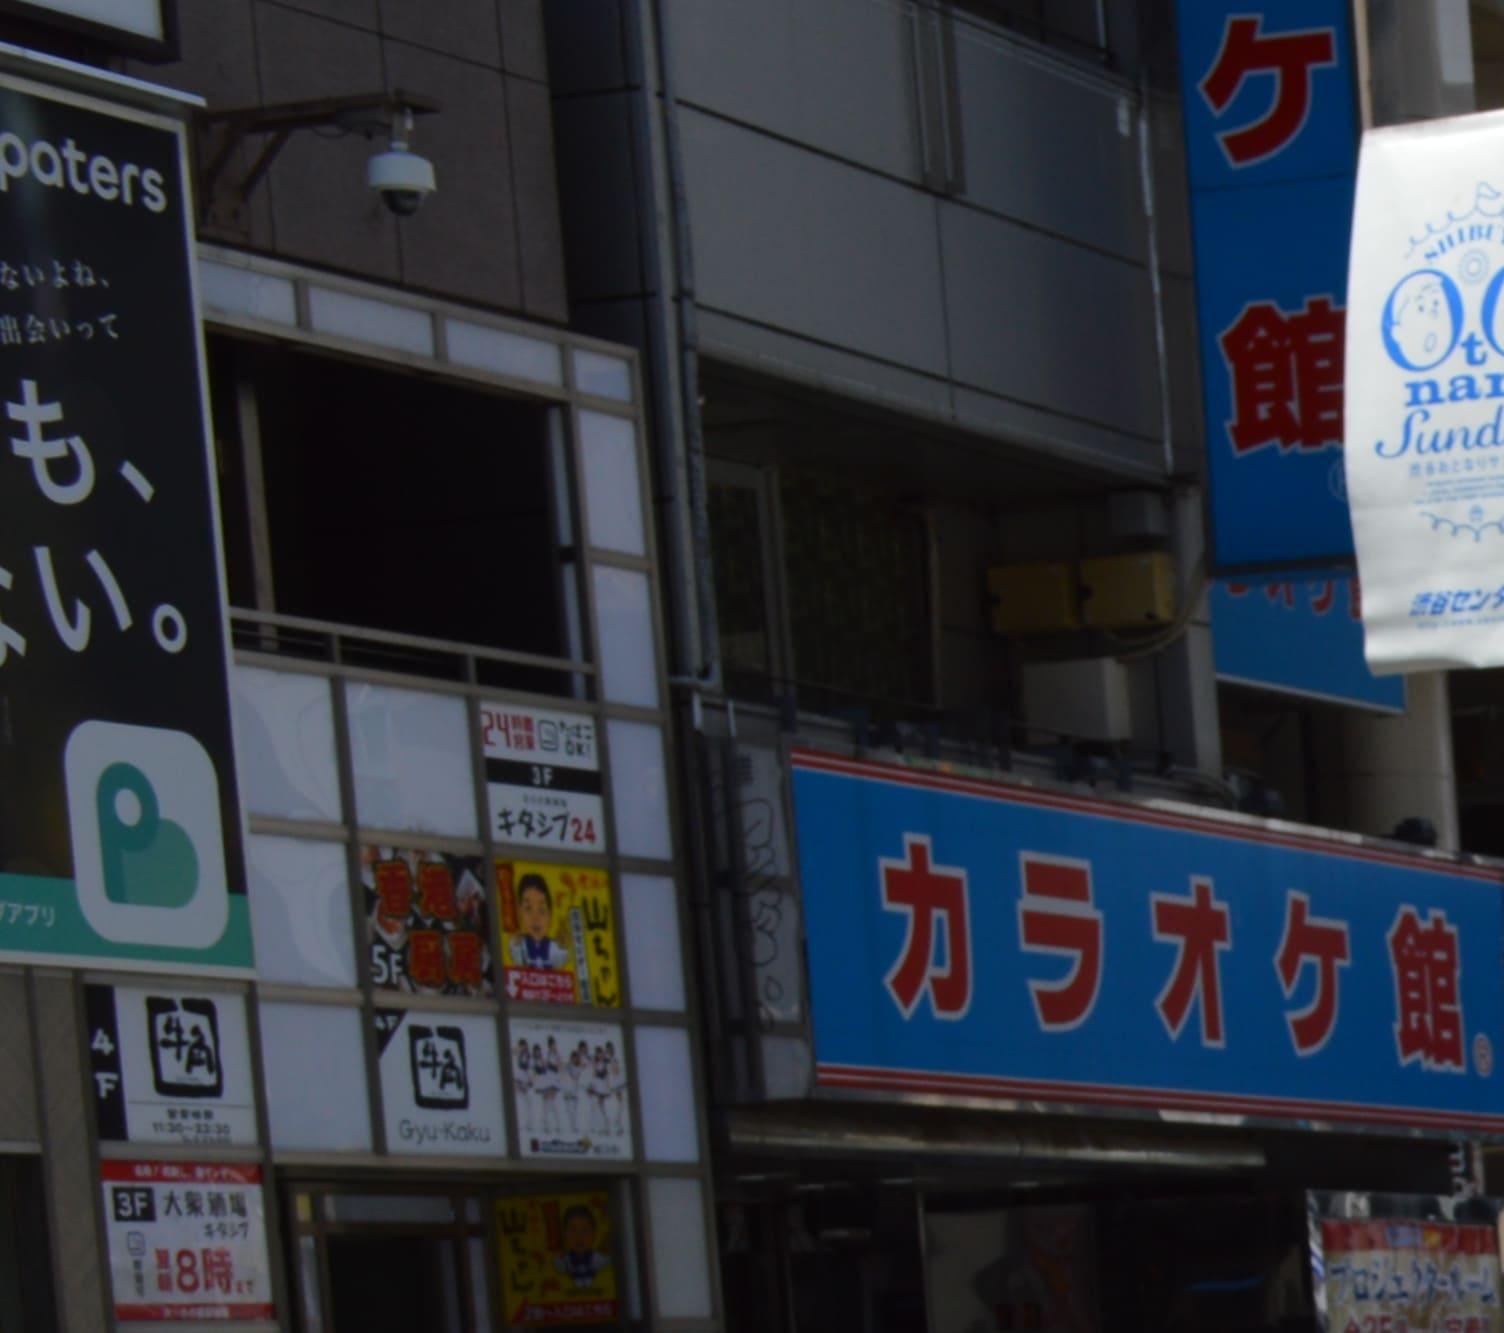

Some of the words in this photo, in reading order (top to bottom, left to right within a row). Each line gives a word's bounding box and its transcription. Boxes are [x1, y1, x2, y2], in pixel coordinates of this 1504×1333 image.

[7, 378, 156, 503] も、
[372, 945, 404, 984] 5F
[877, 831, 1467, 1074] カラオケ館
[400, 1118, 491, 1145] Gyu-Kaku
[116, 1192, 149, 1218] 3F
